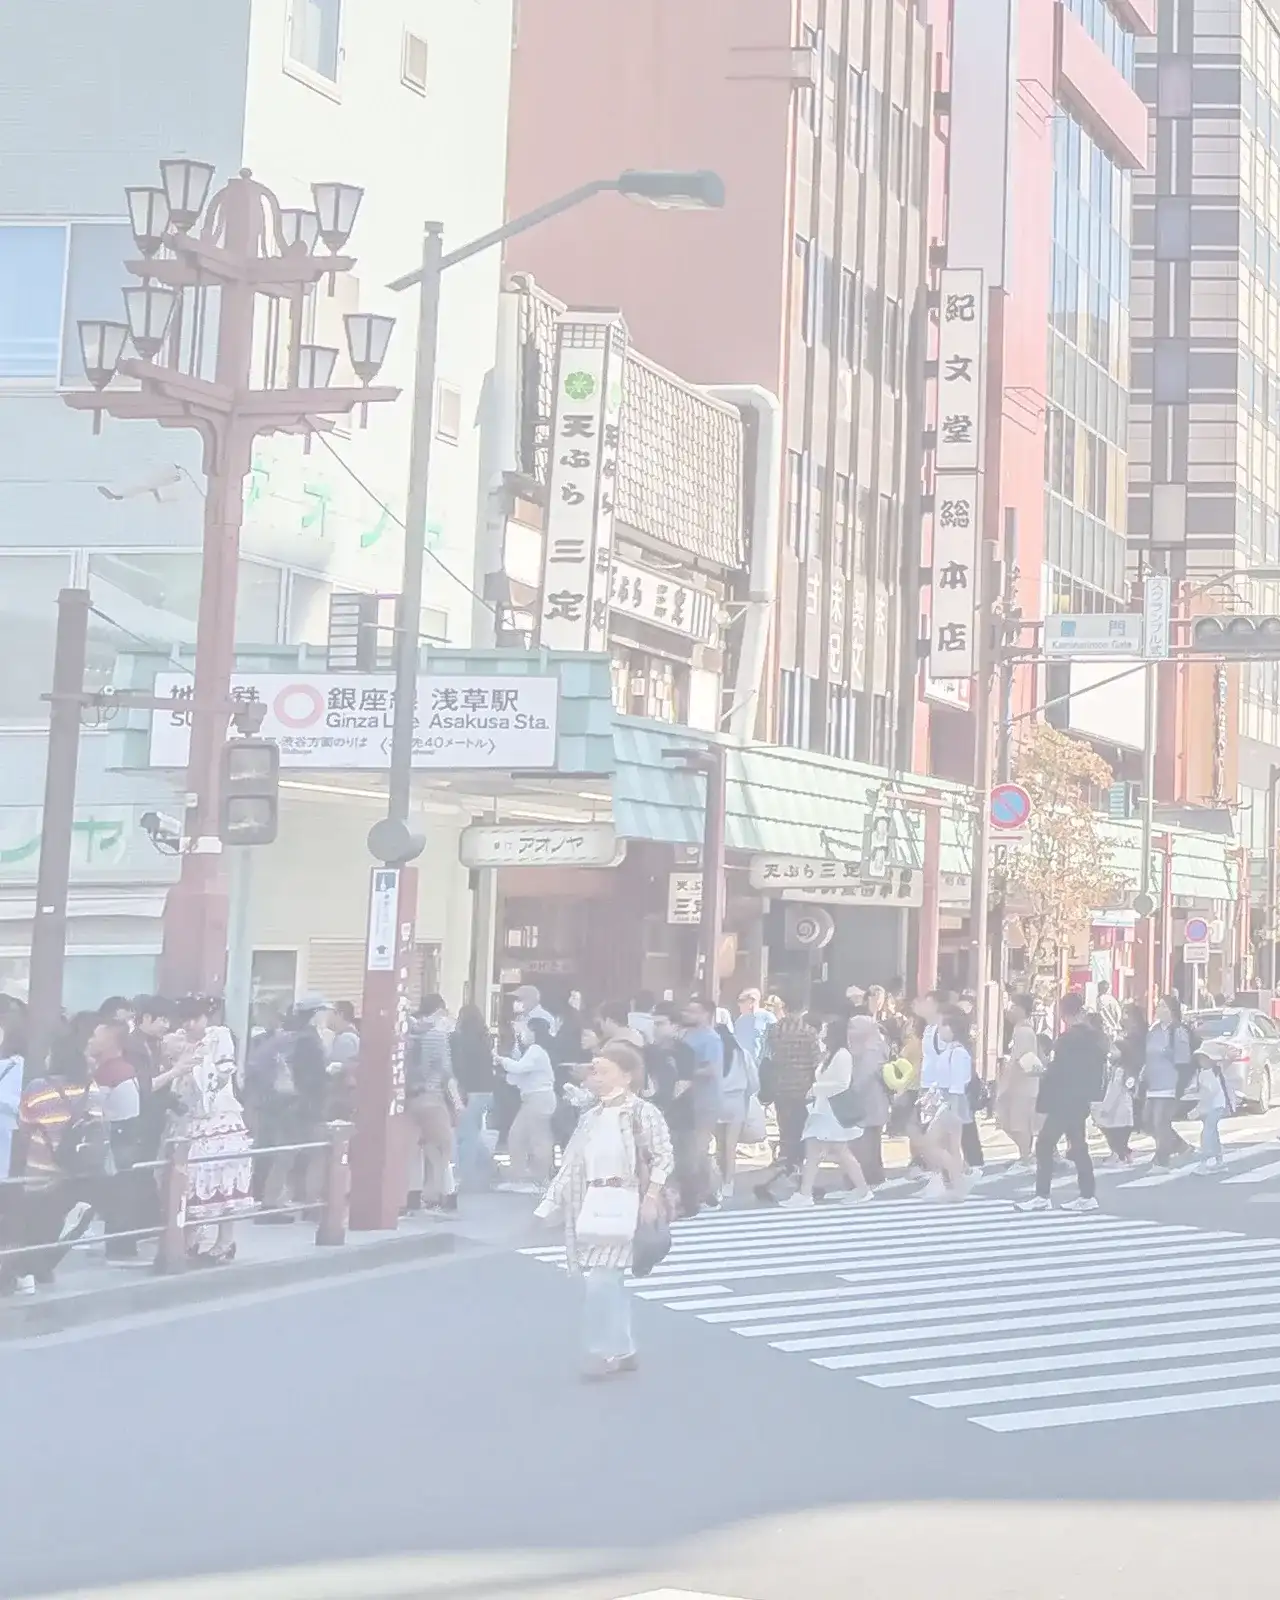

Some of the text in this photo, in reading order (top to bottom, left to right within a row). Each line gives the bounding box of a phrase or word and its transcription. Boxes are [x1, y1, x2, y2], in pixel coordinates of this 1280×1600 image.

[544, 414, 596, 622] 天ぷら三定
[938, 293, 975, 653] 紀文堂総本店
[326, 712, 550, 730] Ginza Le Asakusa Sta.
[431, 688, 520, 712] 浅草駅
